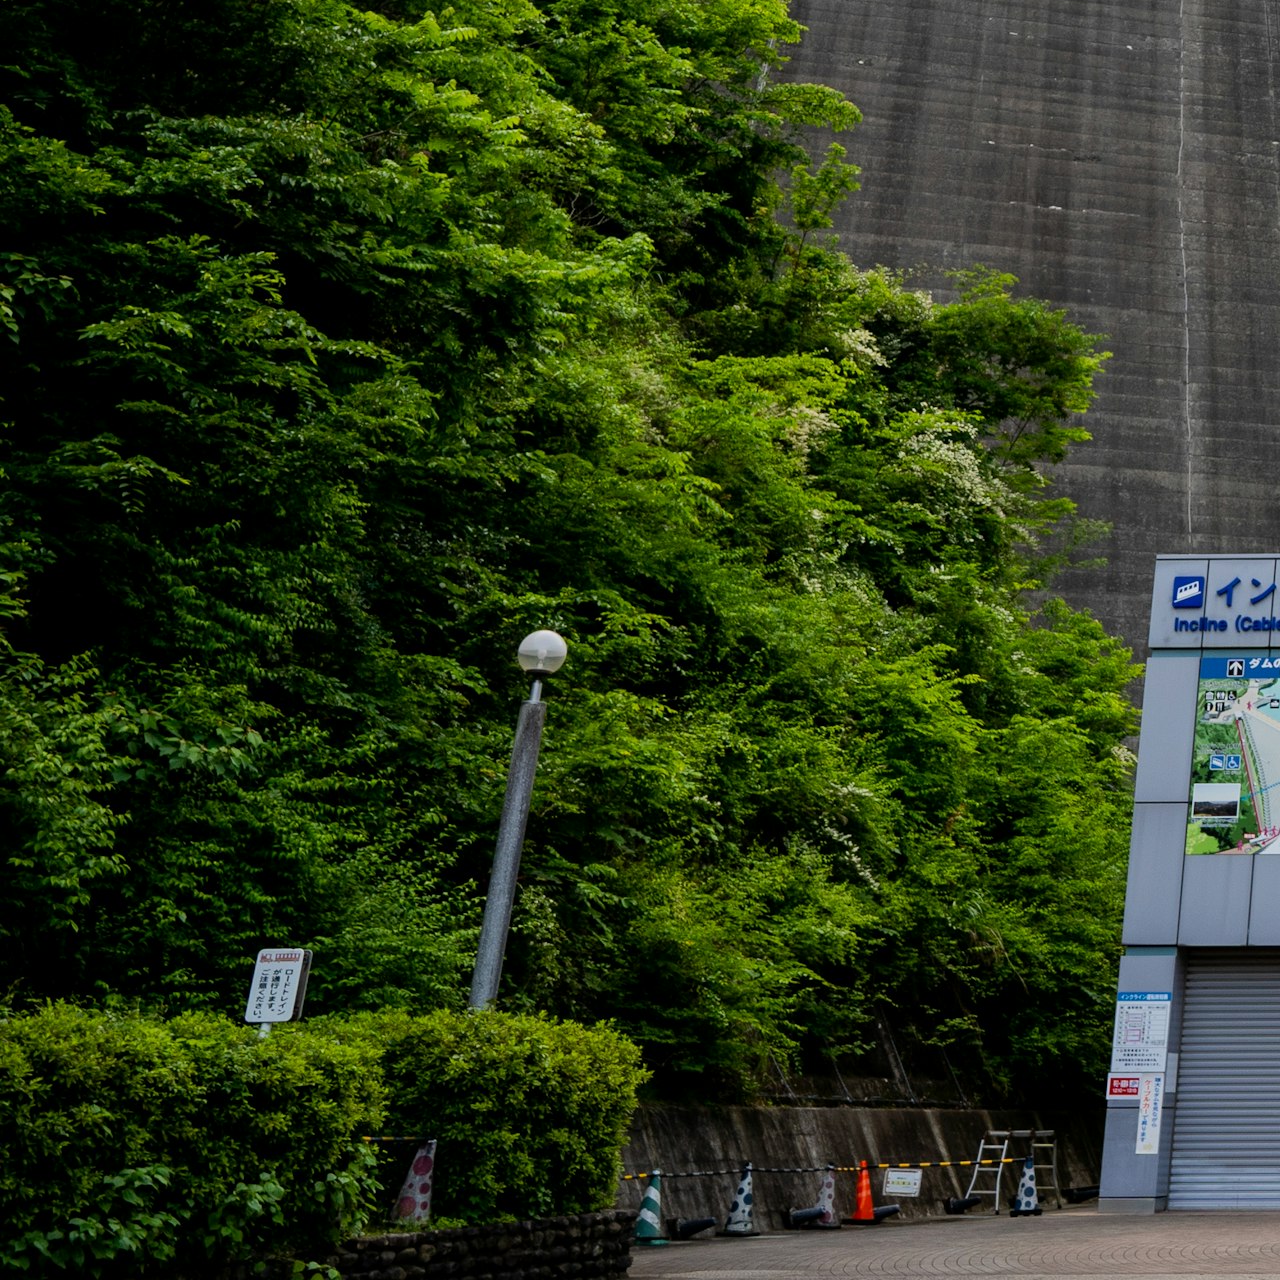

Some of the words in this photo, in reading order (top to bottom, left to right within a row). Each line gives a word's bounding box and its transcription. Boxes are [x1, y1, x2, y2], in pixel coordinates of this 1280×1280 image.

[1174, 617, 1228, 632] Incline
[253, 968, 271, 1019] ご注意ください。
[268, 968, 282, 1012] が通行します。
[277, 969, 294, 1016] ロードトレイン
